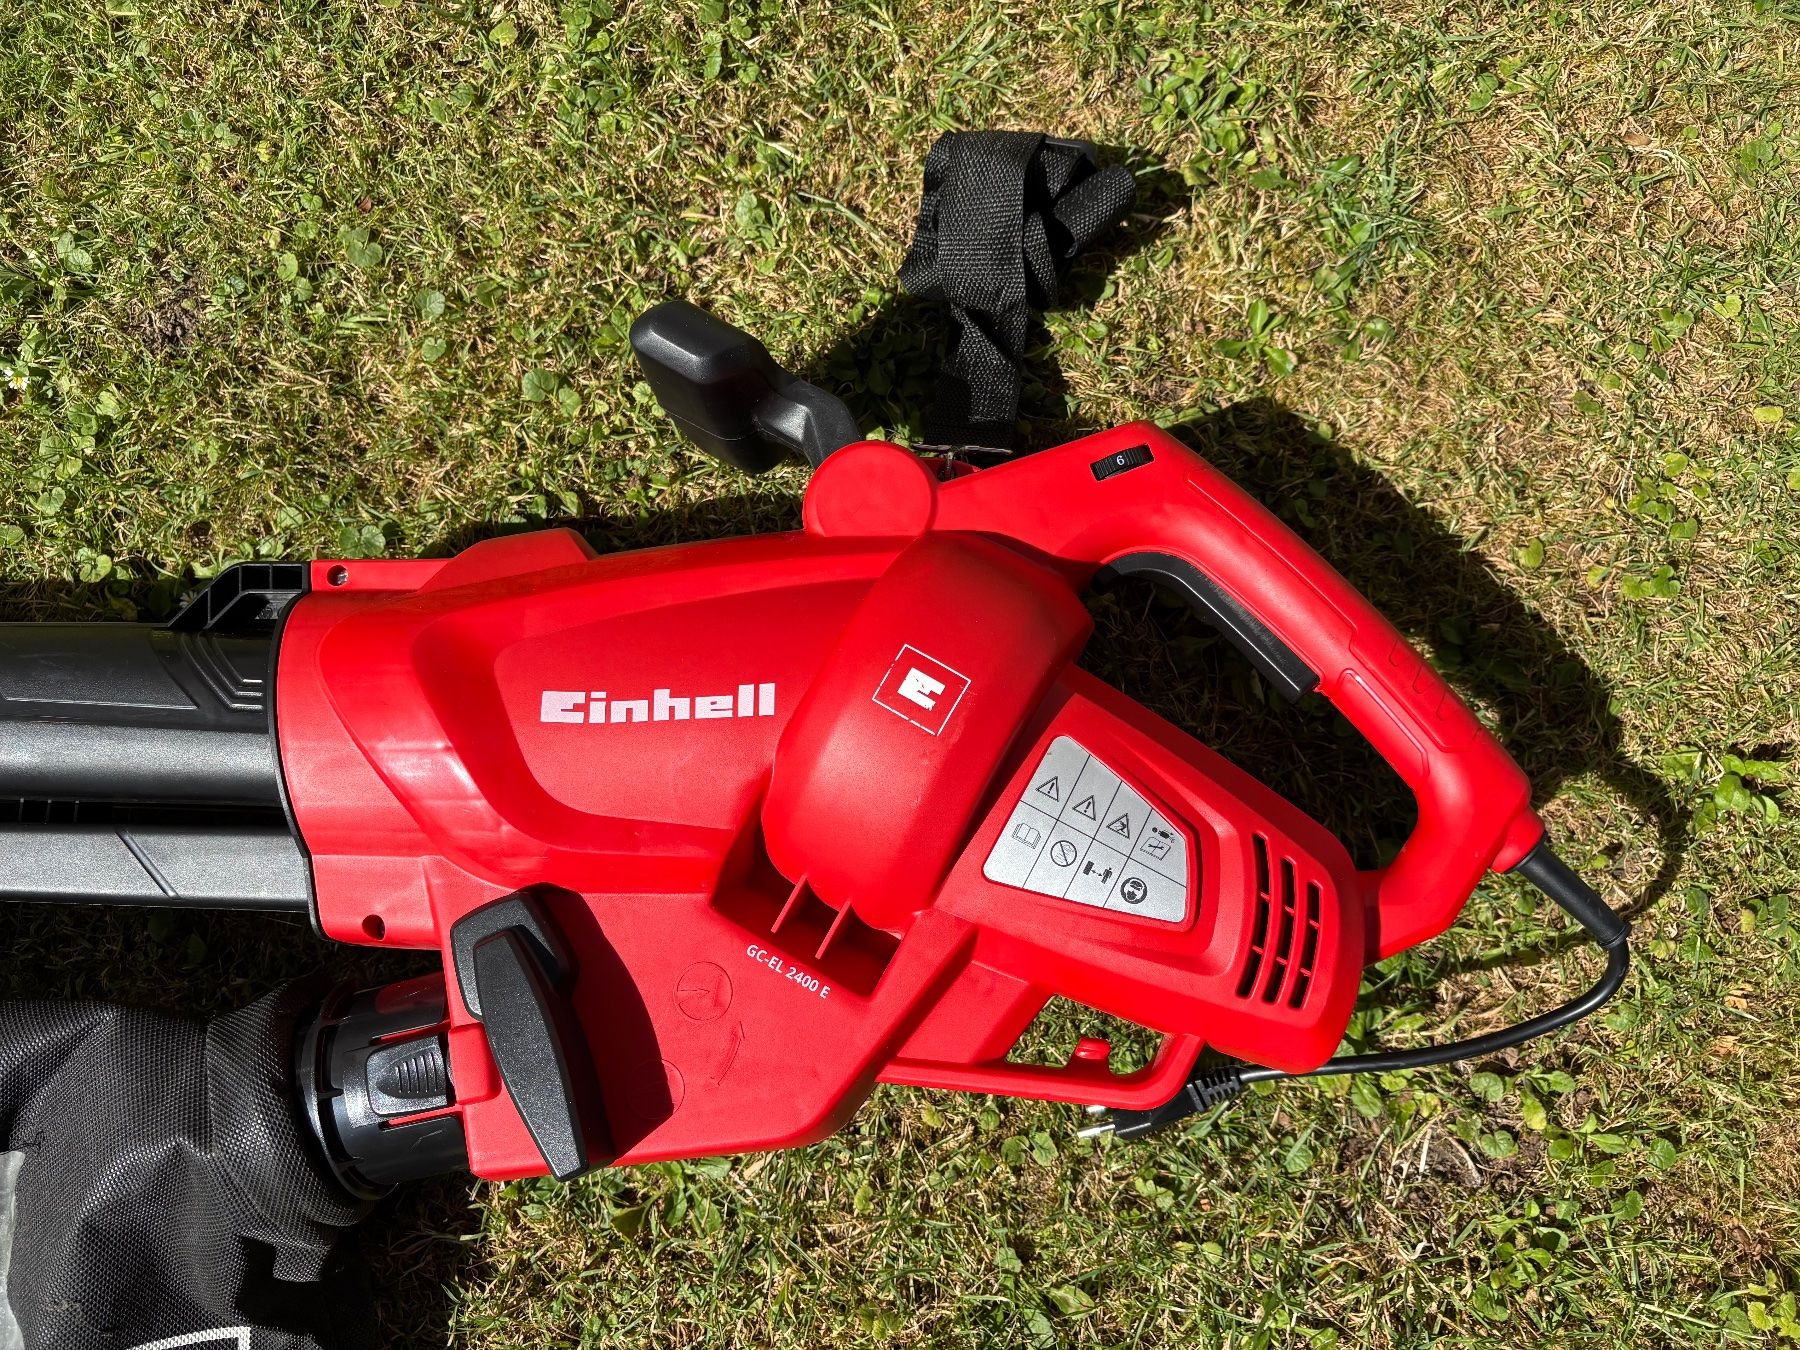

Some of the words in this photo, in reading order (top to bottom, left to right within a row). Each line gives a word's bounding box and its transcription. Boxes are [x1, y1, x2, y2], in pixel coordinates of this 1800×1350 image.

[1116, 455, 1125, 466] 6
[540, 682, 776, 724] Einhell
[897, 667, 946, 711] E
[746, 944, 783, 973] GC-EL
[785, 966, 819, 992] 2400
[820, 985, 831, 999] E
